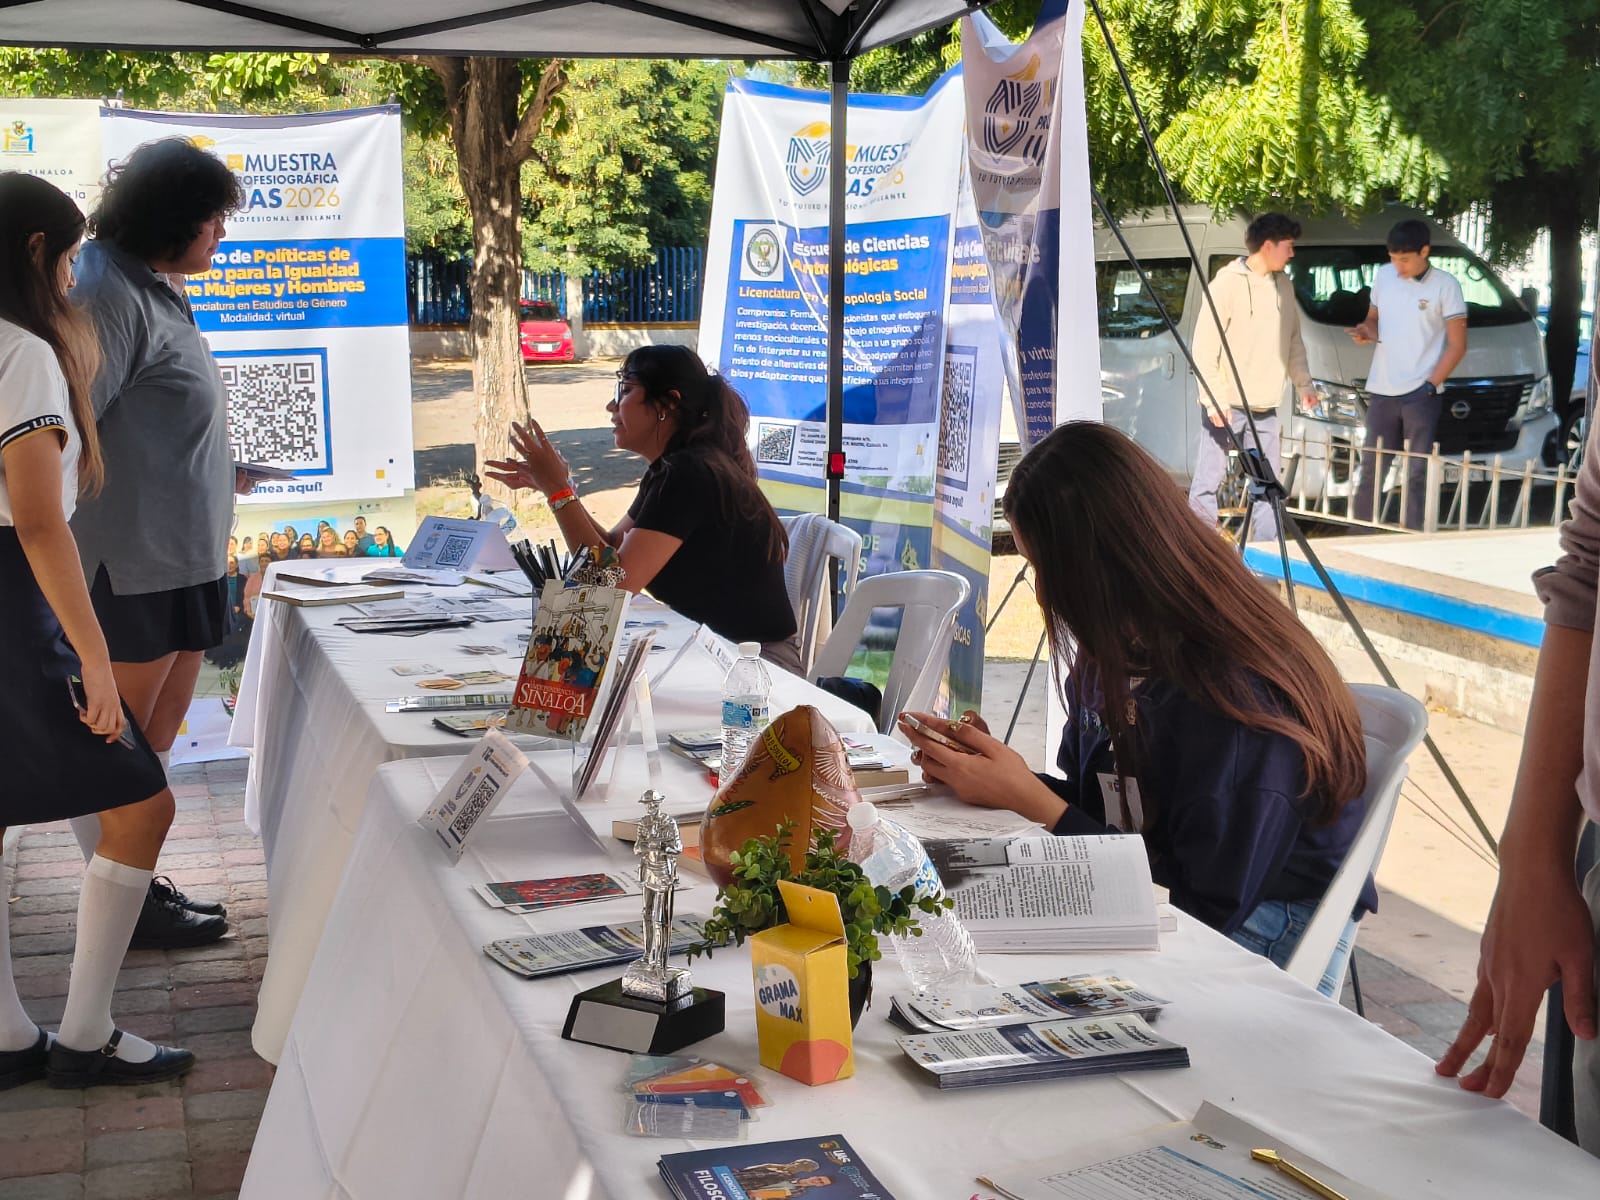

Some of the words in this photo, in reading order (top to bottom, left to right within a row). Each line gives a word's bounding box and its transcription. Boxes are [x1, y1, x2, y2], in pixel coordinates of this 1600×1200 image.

[245, 152, 337, 172] MUESTRA
[236, 172, 340, 186] ROFESIOGRÁFICA
[846, 178, 875, 197] AS
[284, 186, 341, 208] 2026
[792, 241, 830, 257] Escue
[844, 239, 860, 254] de
[862, 234, 930, 253] Ciencias
[229, 249, 251, 264] de
[253, 248, 327, 264] Políticas
[328, 246, 350, 262] de
[225, 266, 264, 282] para
[266, 264, 282, 279] la
[285, 262, 359, 281] Igualdad
[204, 283, 271, 298] Mujeres
[273, 283, 285, 297] y
[287, 279, 366, 295] Hombres
[739, 286, 801, 299] Licenciatura
[894, 288, 927, 300] Social
[191, 301, 235, 312] enciatura
[237, 302, 250, 310] en
[252, 300, 294, 310] Estudios
[296, 299, 309, 309] de
[311, 297, 347, 308] Género
[220, 312, 274, 323] Modalidad:
[276, 311, 305, 321] virtual
[881, 313, 896, 322] que
[734, 333, 762, 341] menos
[891, 338, 912, 348] grupo
[746, 344, 756, 353] de
[802, 349, 811, 357] su
[1028, 346, 1056, 361] virtu
[761, 358, 772, 367] de
[808, 374, 823, 384] que
[250, 484, 284, 494] anea
[518, 682, 586, 716] SINALOA
[758, 979, 798, 1004] GRAMA
[779, 1001, 803, 1024] MAX
